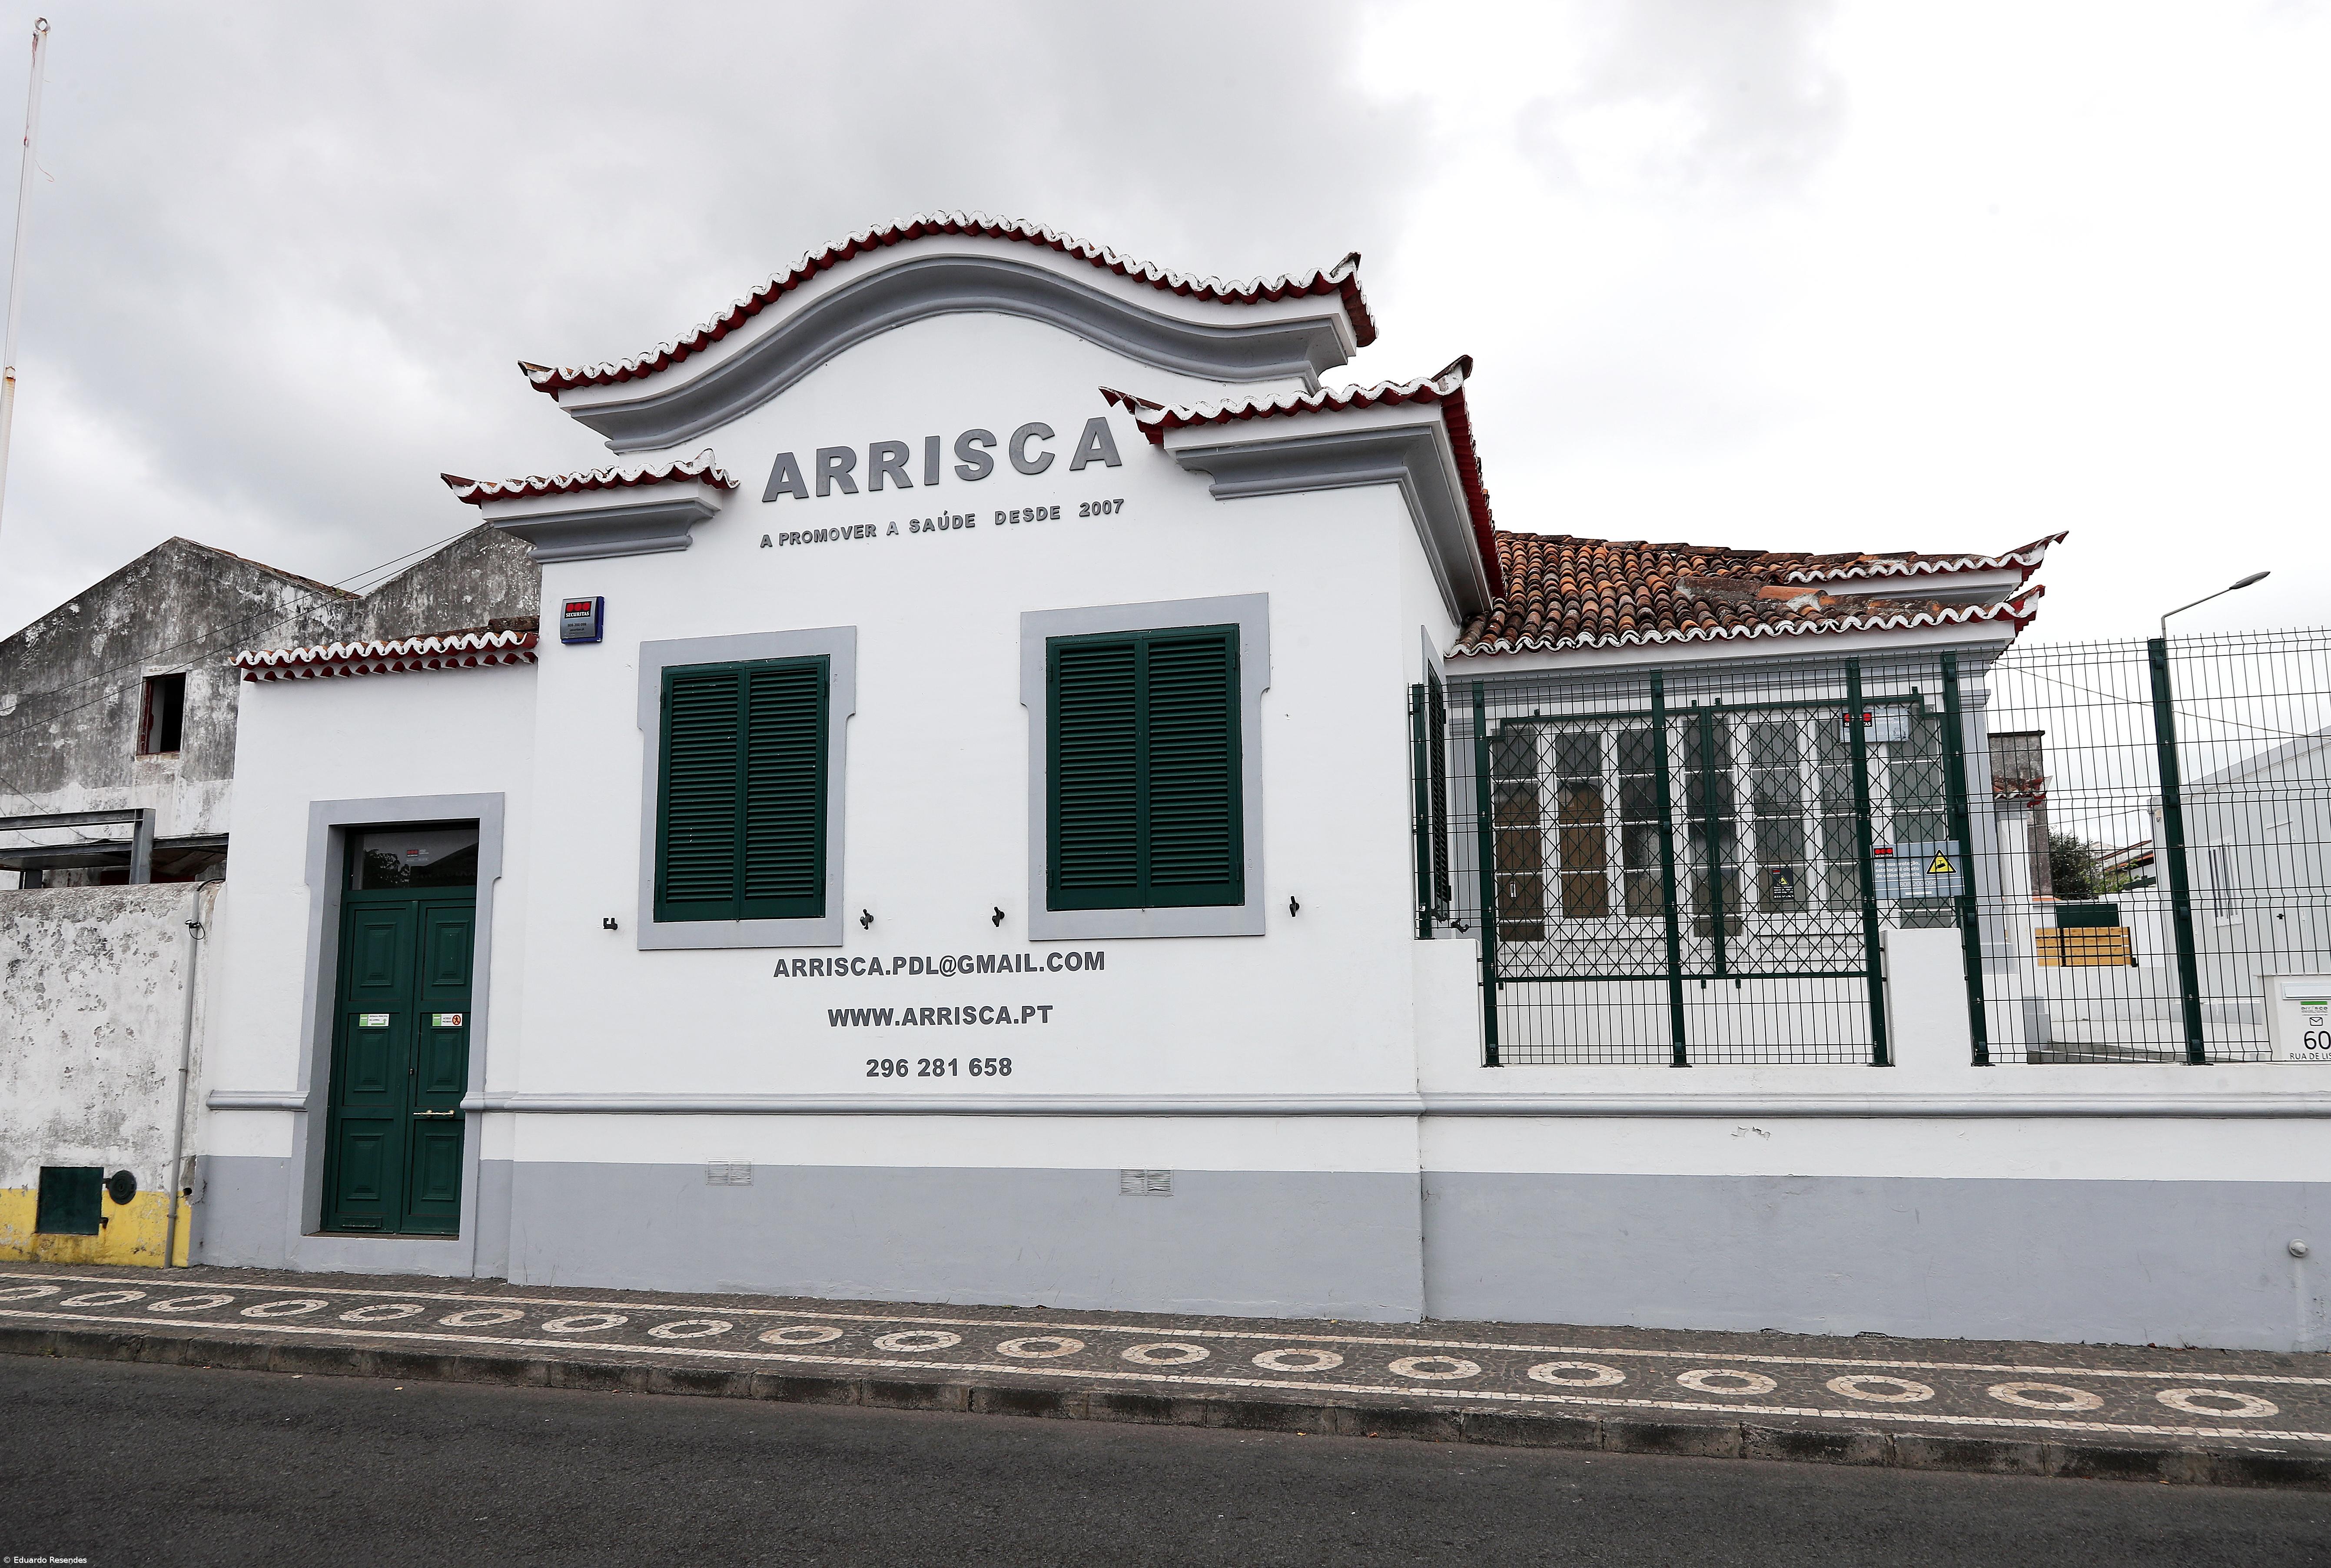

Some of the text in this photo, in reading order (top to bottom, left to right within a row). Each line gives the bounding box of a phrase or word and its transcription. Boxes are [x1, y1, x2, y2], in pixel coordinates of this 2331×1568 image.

[761, 416, 1122, 503] ARRISCA
[760, 498, 1124, 548] A PROMOVER A SAÚDE DESDE 2007
[773, 951, 1104, 977] ARRISCA.PDL@GMAIL.COM
[827, 1005, 1053, 1027] WWW.ARRISCA.PT
[2304, 1030, 2331, 1050] 60
[866, 1057, 1012, 1078] 296 281 658
